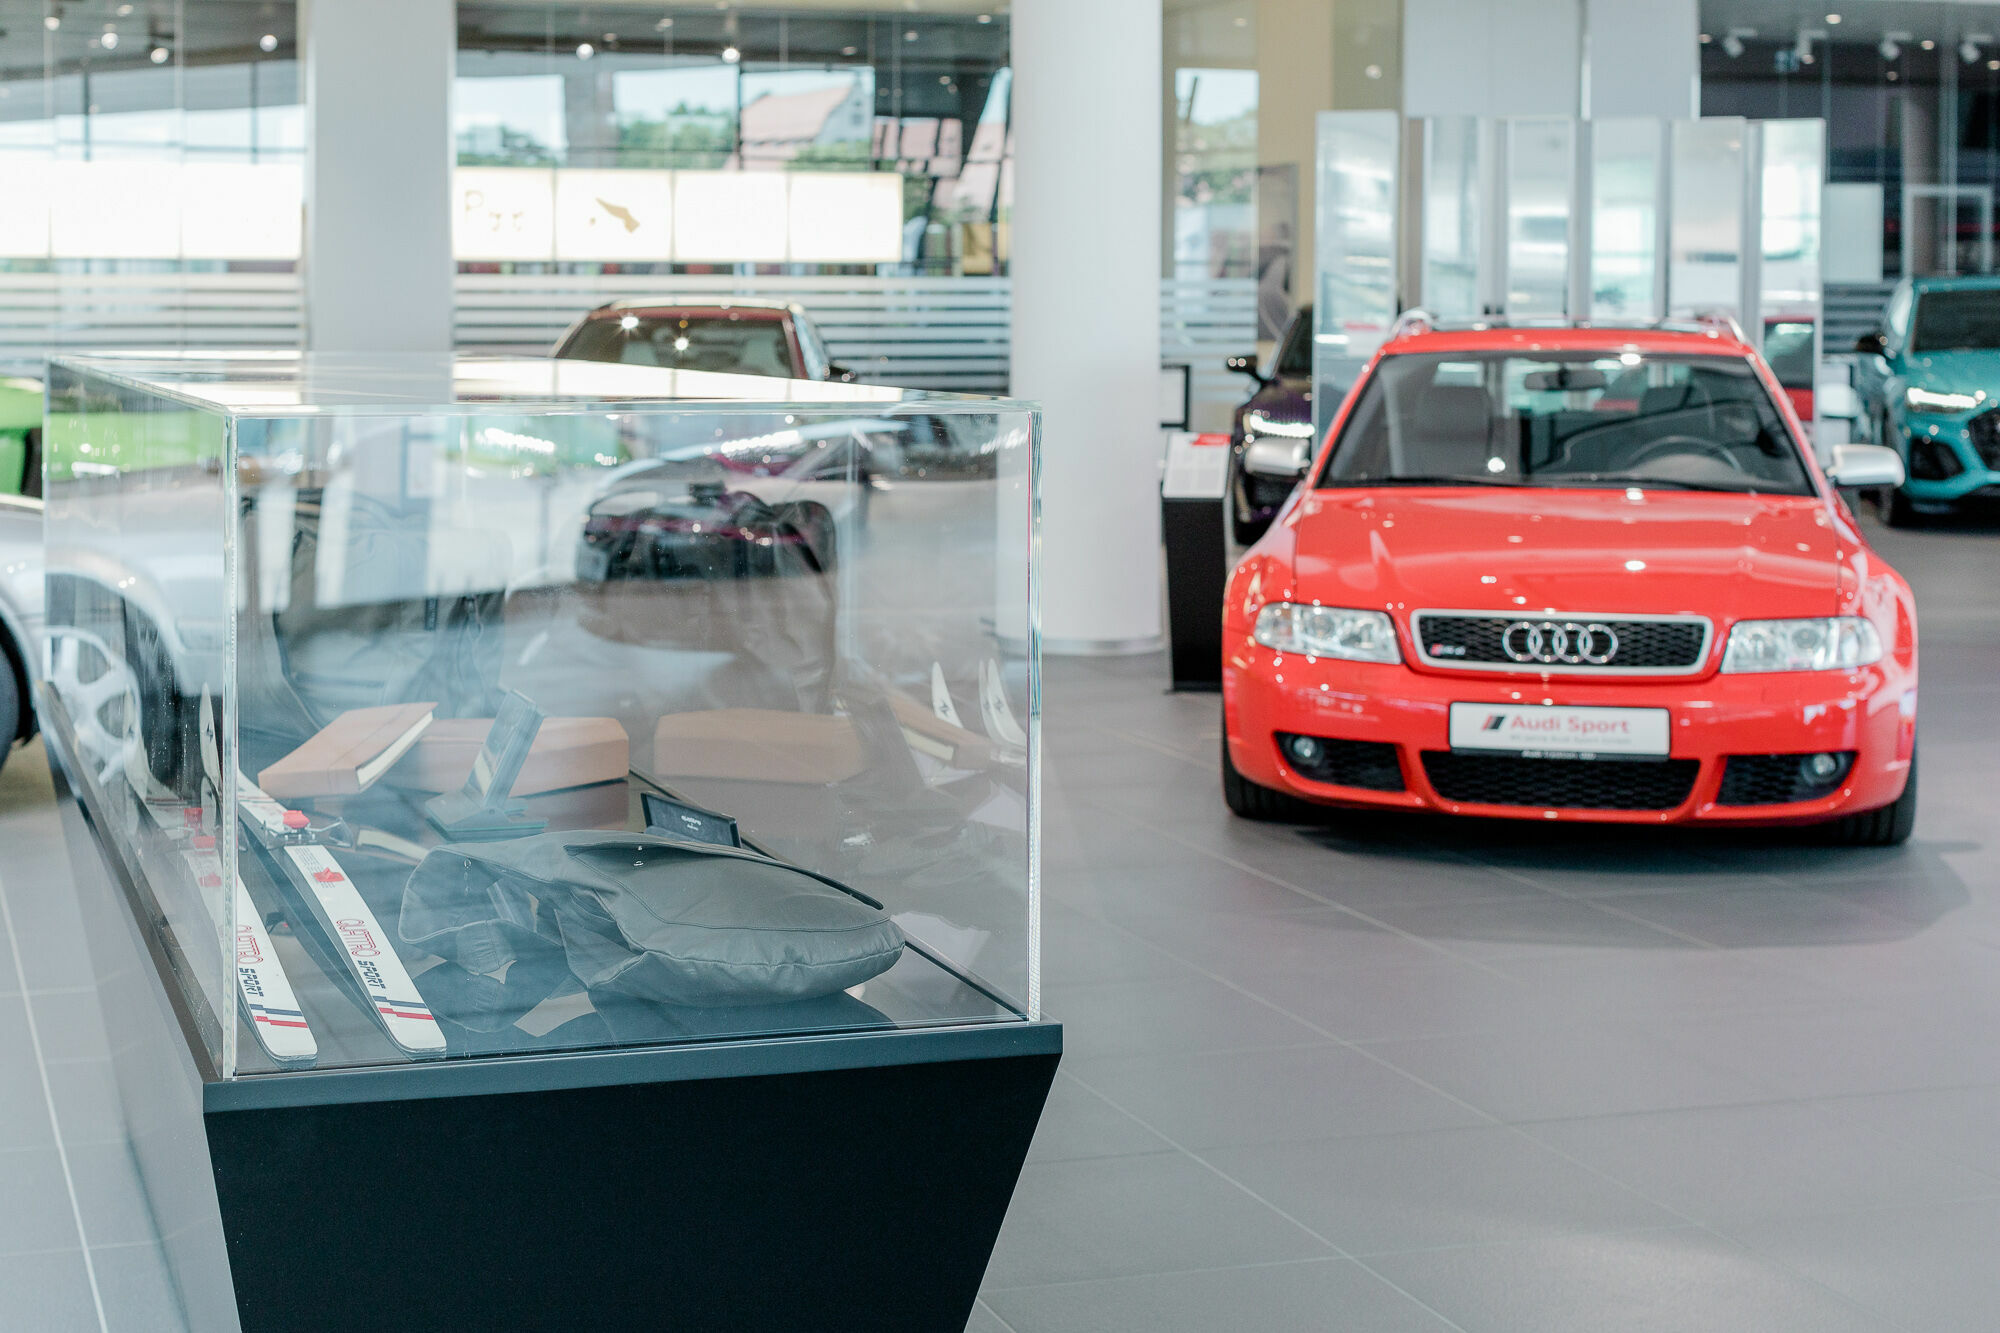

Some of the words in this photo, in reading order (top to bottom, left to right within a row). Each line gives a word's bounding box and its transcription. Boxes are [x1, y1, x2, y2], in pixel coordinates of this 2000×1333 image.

[1511, 715, 1560, 730] Audi
[1568, 716, 1630, 734] Sport
[239, 967, 264, 997] SPORT
[357, 960, 386, 989] SPORT
